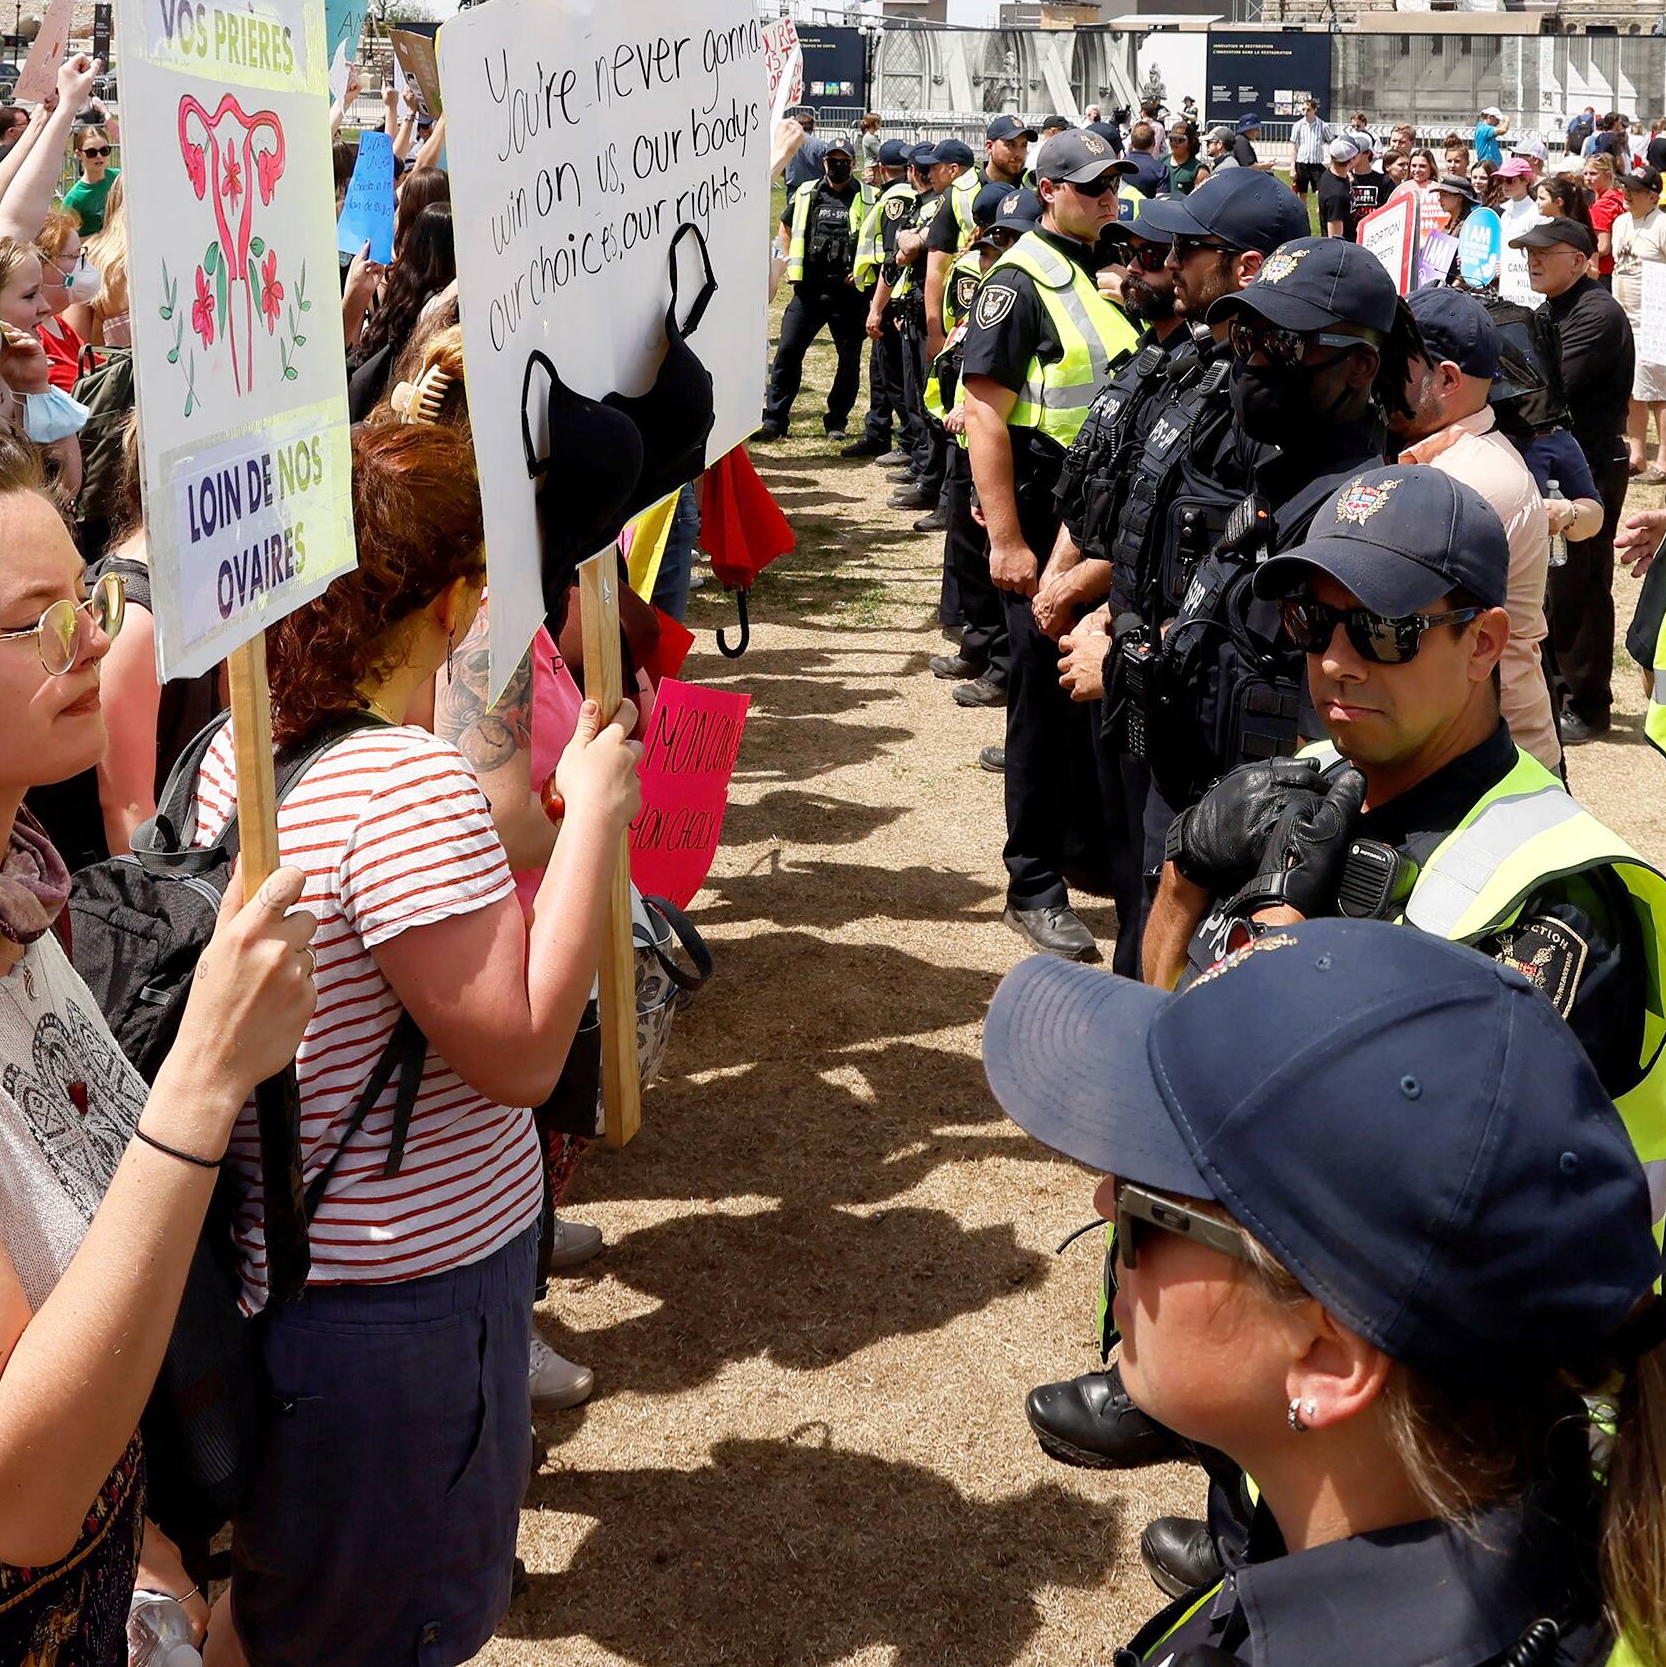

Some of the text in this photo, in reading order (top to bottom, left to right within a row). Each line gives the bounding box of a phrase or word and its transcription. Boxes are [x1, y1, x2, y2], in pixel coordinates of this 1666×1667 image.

[485, 49, 581, 162] You're
[595, 35, 692, 108] never
[702, 18, 762, 115] gonna
[492, 98, 760, 256] win on us, our bodys
[489, 275, 525, 351] our
[623, 199, 667, 250] our
[675, 166, 748, 240] rights.
[187, 434, 324, 545] LOIN DE NOS
[216, 521, 307, 620] OVAIRES
[645, 704, 709, 774] MON
[1360, 848, 1387, 863] MOTOROLA
